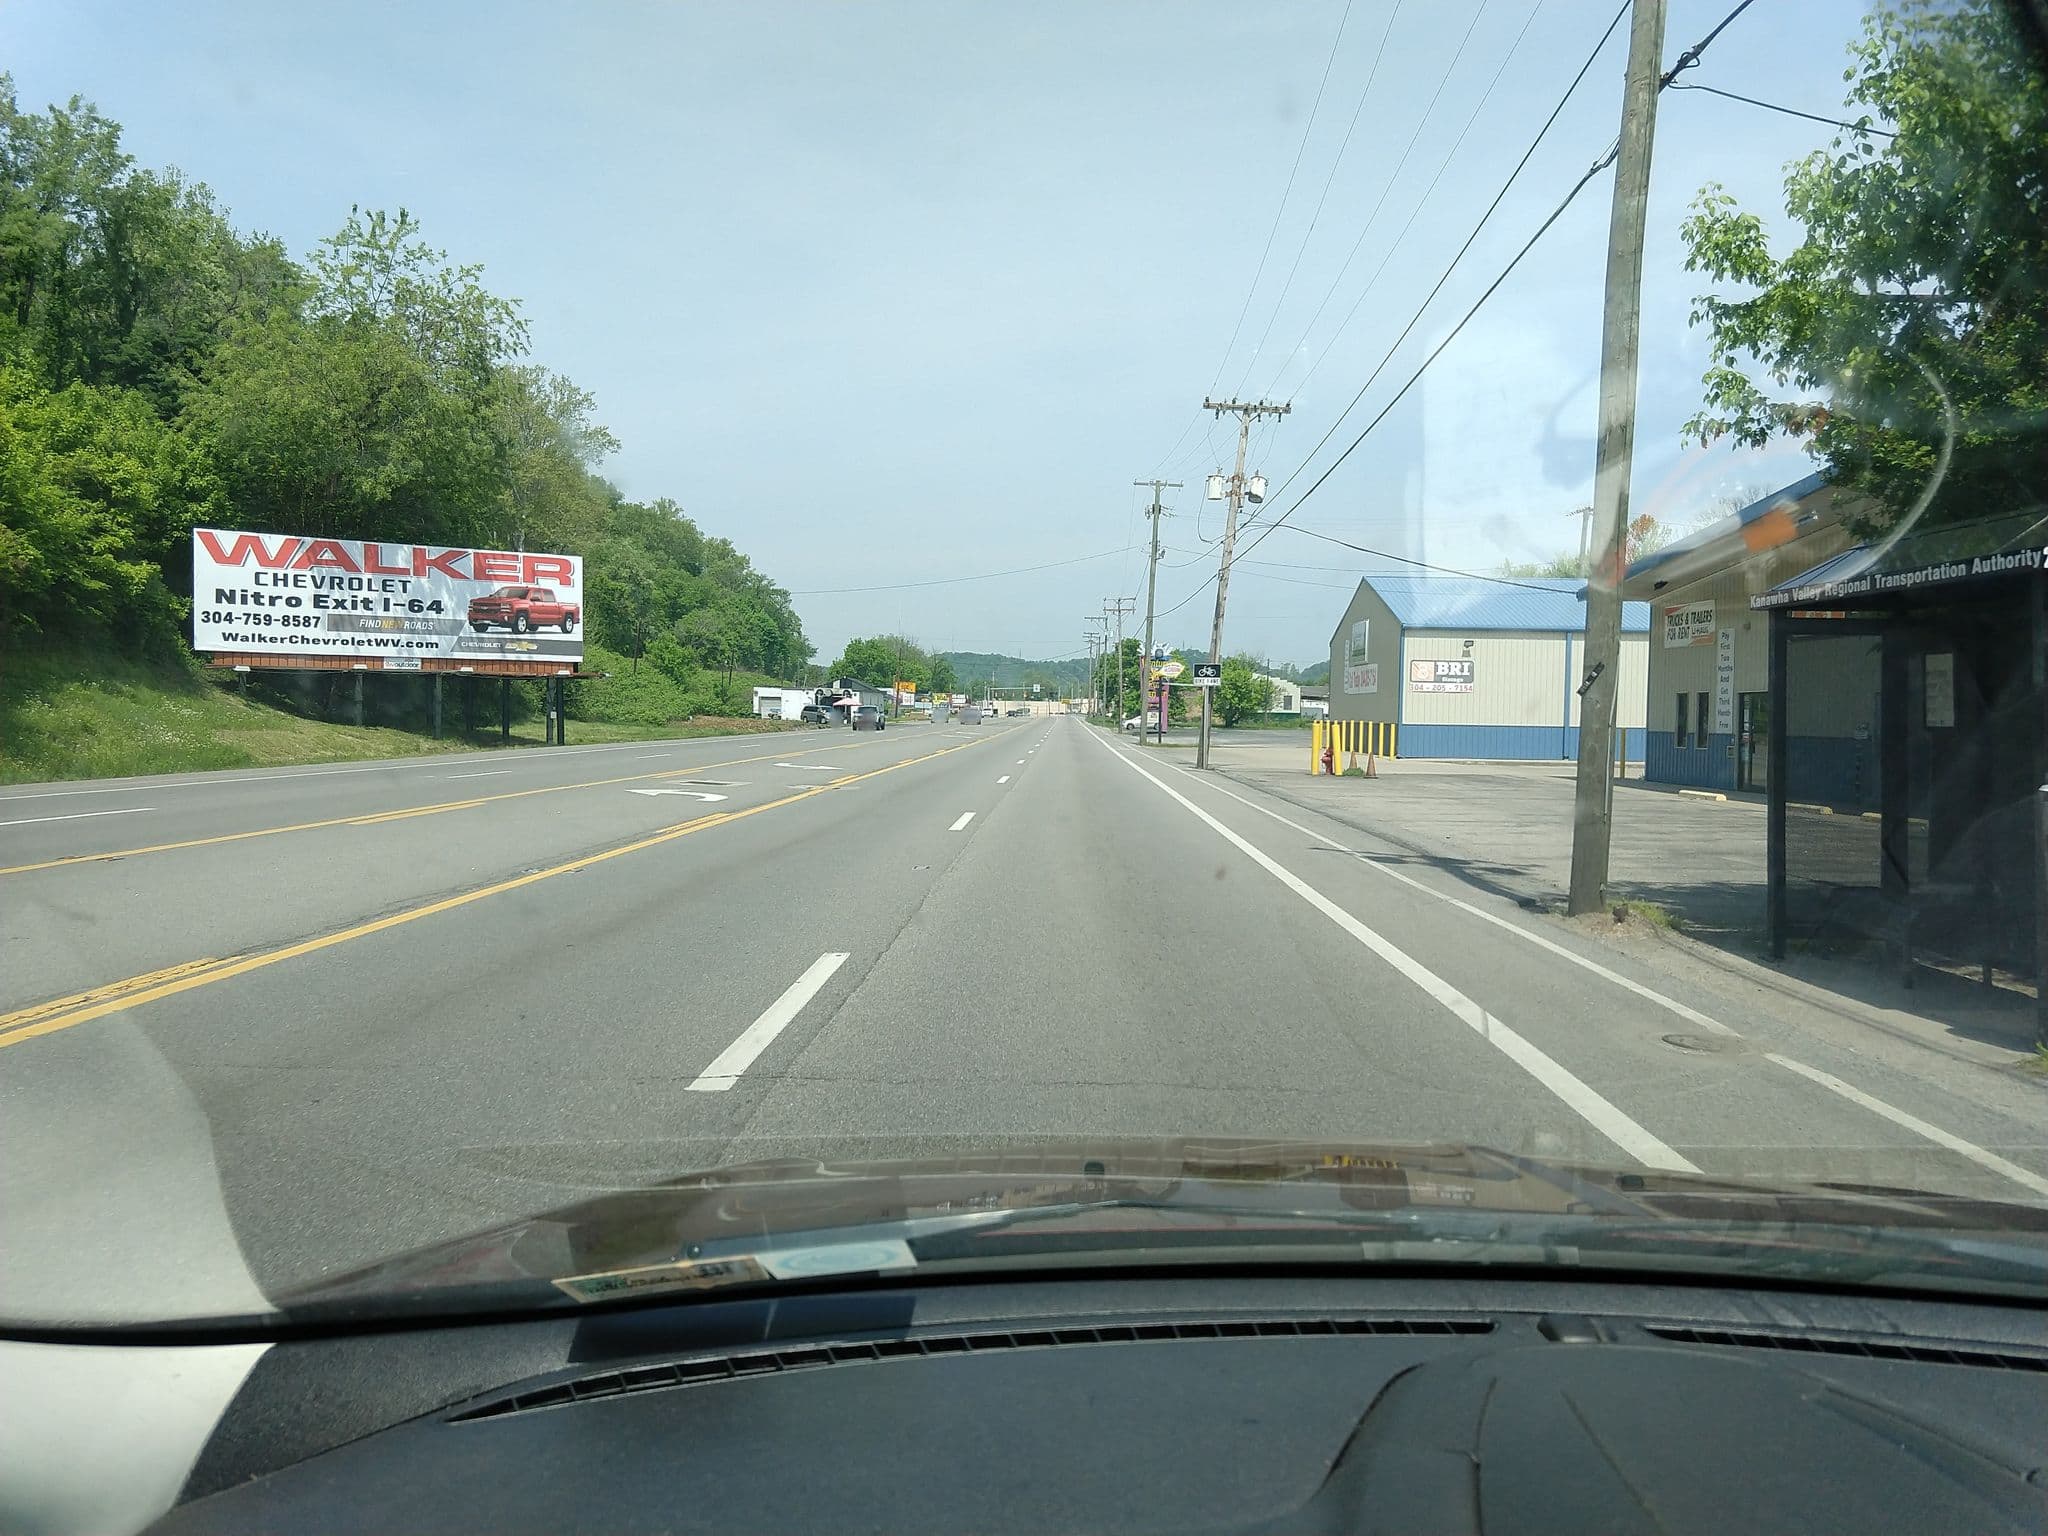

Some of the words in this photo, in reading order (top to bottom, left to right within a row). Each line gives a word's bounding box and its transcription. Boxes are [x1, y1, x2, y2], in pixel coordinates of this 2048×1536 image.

[196, 531, 574, 588] WALKER
[254, 571, 412, 594] CHEVROLET
[1750, 591, 1790, 609] Kanawha
[1792, 583, 1821, 602] Valley
[1824, 575, 1871, 597] Regional
[1874, 562, 1967, 588] Transportation
[1971, 548, 2042, 575] Authority
[215, 588, 303, 608] Nitro
[313, 593, 373, 612] Exit
[383, 597, 445, 615] I-64
[201, 610, 322, 628] 304-759-8587
[360, 618, 381, 629] FIND
[403, 620, 435, 631] ROADS
[1667, 611, 1684, 628] TRUCKS
[1684, 612, 1690, 626] &
[1690, 609, 1713, 625] TRAILERS
[221, 631, 440, 649] WalkerChevroletWV.com
[1667, 628, 1677, 641] FOR
[1677, 626, 1690, 640] RENT
[1436, 662, 1471, 676] BRI
